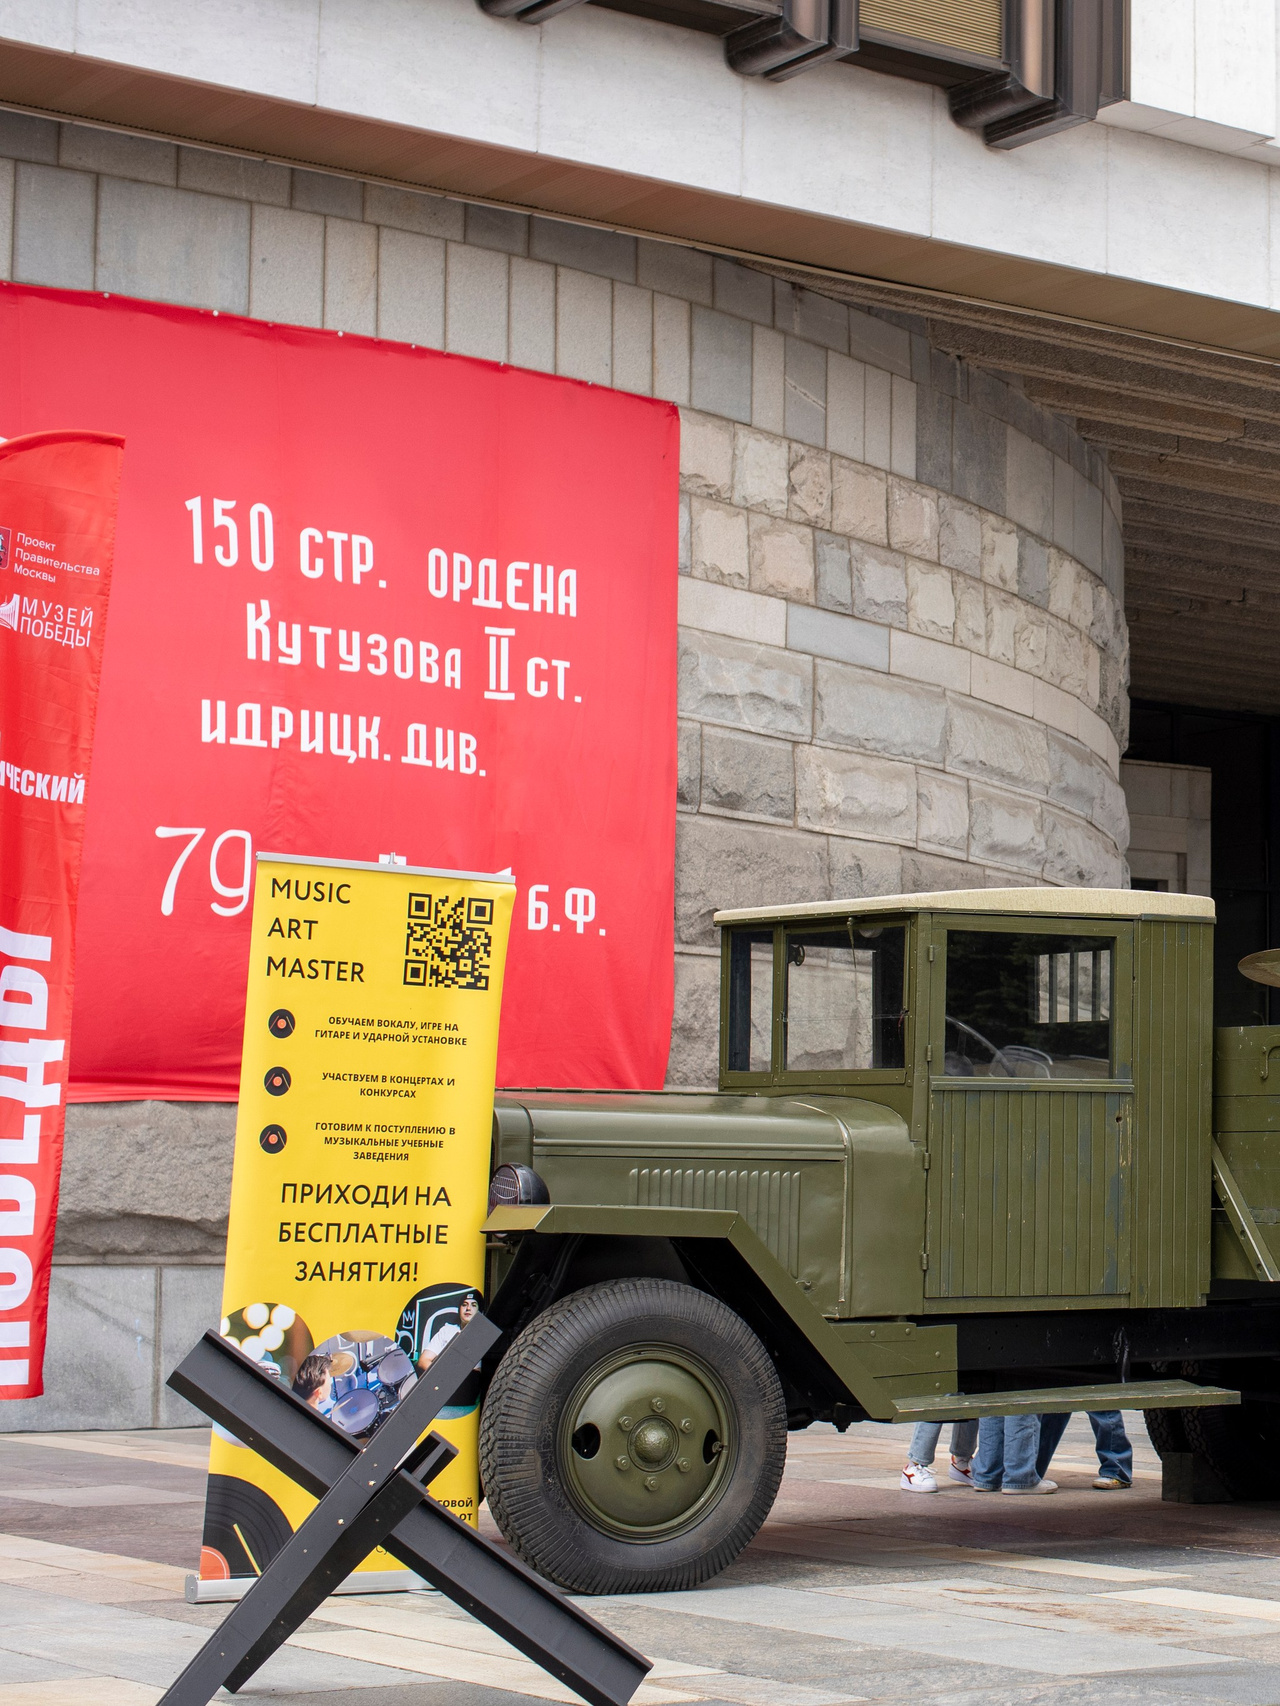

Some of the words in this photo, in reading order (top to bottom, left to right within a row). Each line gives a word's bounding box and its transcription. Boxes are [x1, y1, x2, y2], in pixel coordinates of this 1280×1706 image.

[16, 532, 56, 551] Проект
[15, 548, 100, 576] Правительства
[184, 495, 275, 572] 150
[427, 547, 578, 618] ОРДЕНА
[13, 563, 56, 583] Москвы
[22, 597, 94, 628] МУЗЕЙ
[20, 616, 91, 649] ПОБЕДЫ
[154, 825, 252, 917] 79
[271, 877, 352, 904] MUSIC
[267, 917, 319, 940] ART
[266, 956, 365, 983] MASTER
[328, 1016, 375, 1027] ОБУЧАЕМ
[377, 1019, 418, 1030] ВОКАЛУ,
[420, 1021, 442, 1031] ИГРЕ
[444, 1023, 459, 1032] НА
[314, 1029, 350, 1040] ГИТАРЕ
[352, 1031, 360, 1040] И
[362, 1032, 410, 1043] УДАРНОЙ
[411, 1035, 468, 1046] УСТАНОВКЕ
[321, 1072, 379, 1083] УЧАСТВУЕМ
[381, 1075, 387, 1083] В
[390, 1075, 444, 1086] КОНЦЕРТАХ
[447, 1078, 455, 1086] И
[359, 1088, 416, 1098] КОНКУРСАХ
[315, 1122, 363, 1132] ГОТОВИМ
[365, 1124, 372, 1132] К
[374, 1124, 446, 1135] ПОСТУПЛЕНИЮ
[449, 1127, 456, 1135] В
[324, 1137, 399, 1147] МУЗЫКАЛЬНЫЕ
[401, 1139, 444, 1148] УЧЕБНЫЕ
[353, 1152, 409, 1162] ЗАВЕДЕНИЯ
[281, 1182, 408, 1209] ПРИХОДИ
[415, 1185, 452, 1207] НА
[278, 1221, 449, 1245] БЕСПЛАТНЫЕ
[294, 1260, 418, 1282] ЗАНЯТИЯ!
